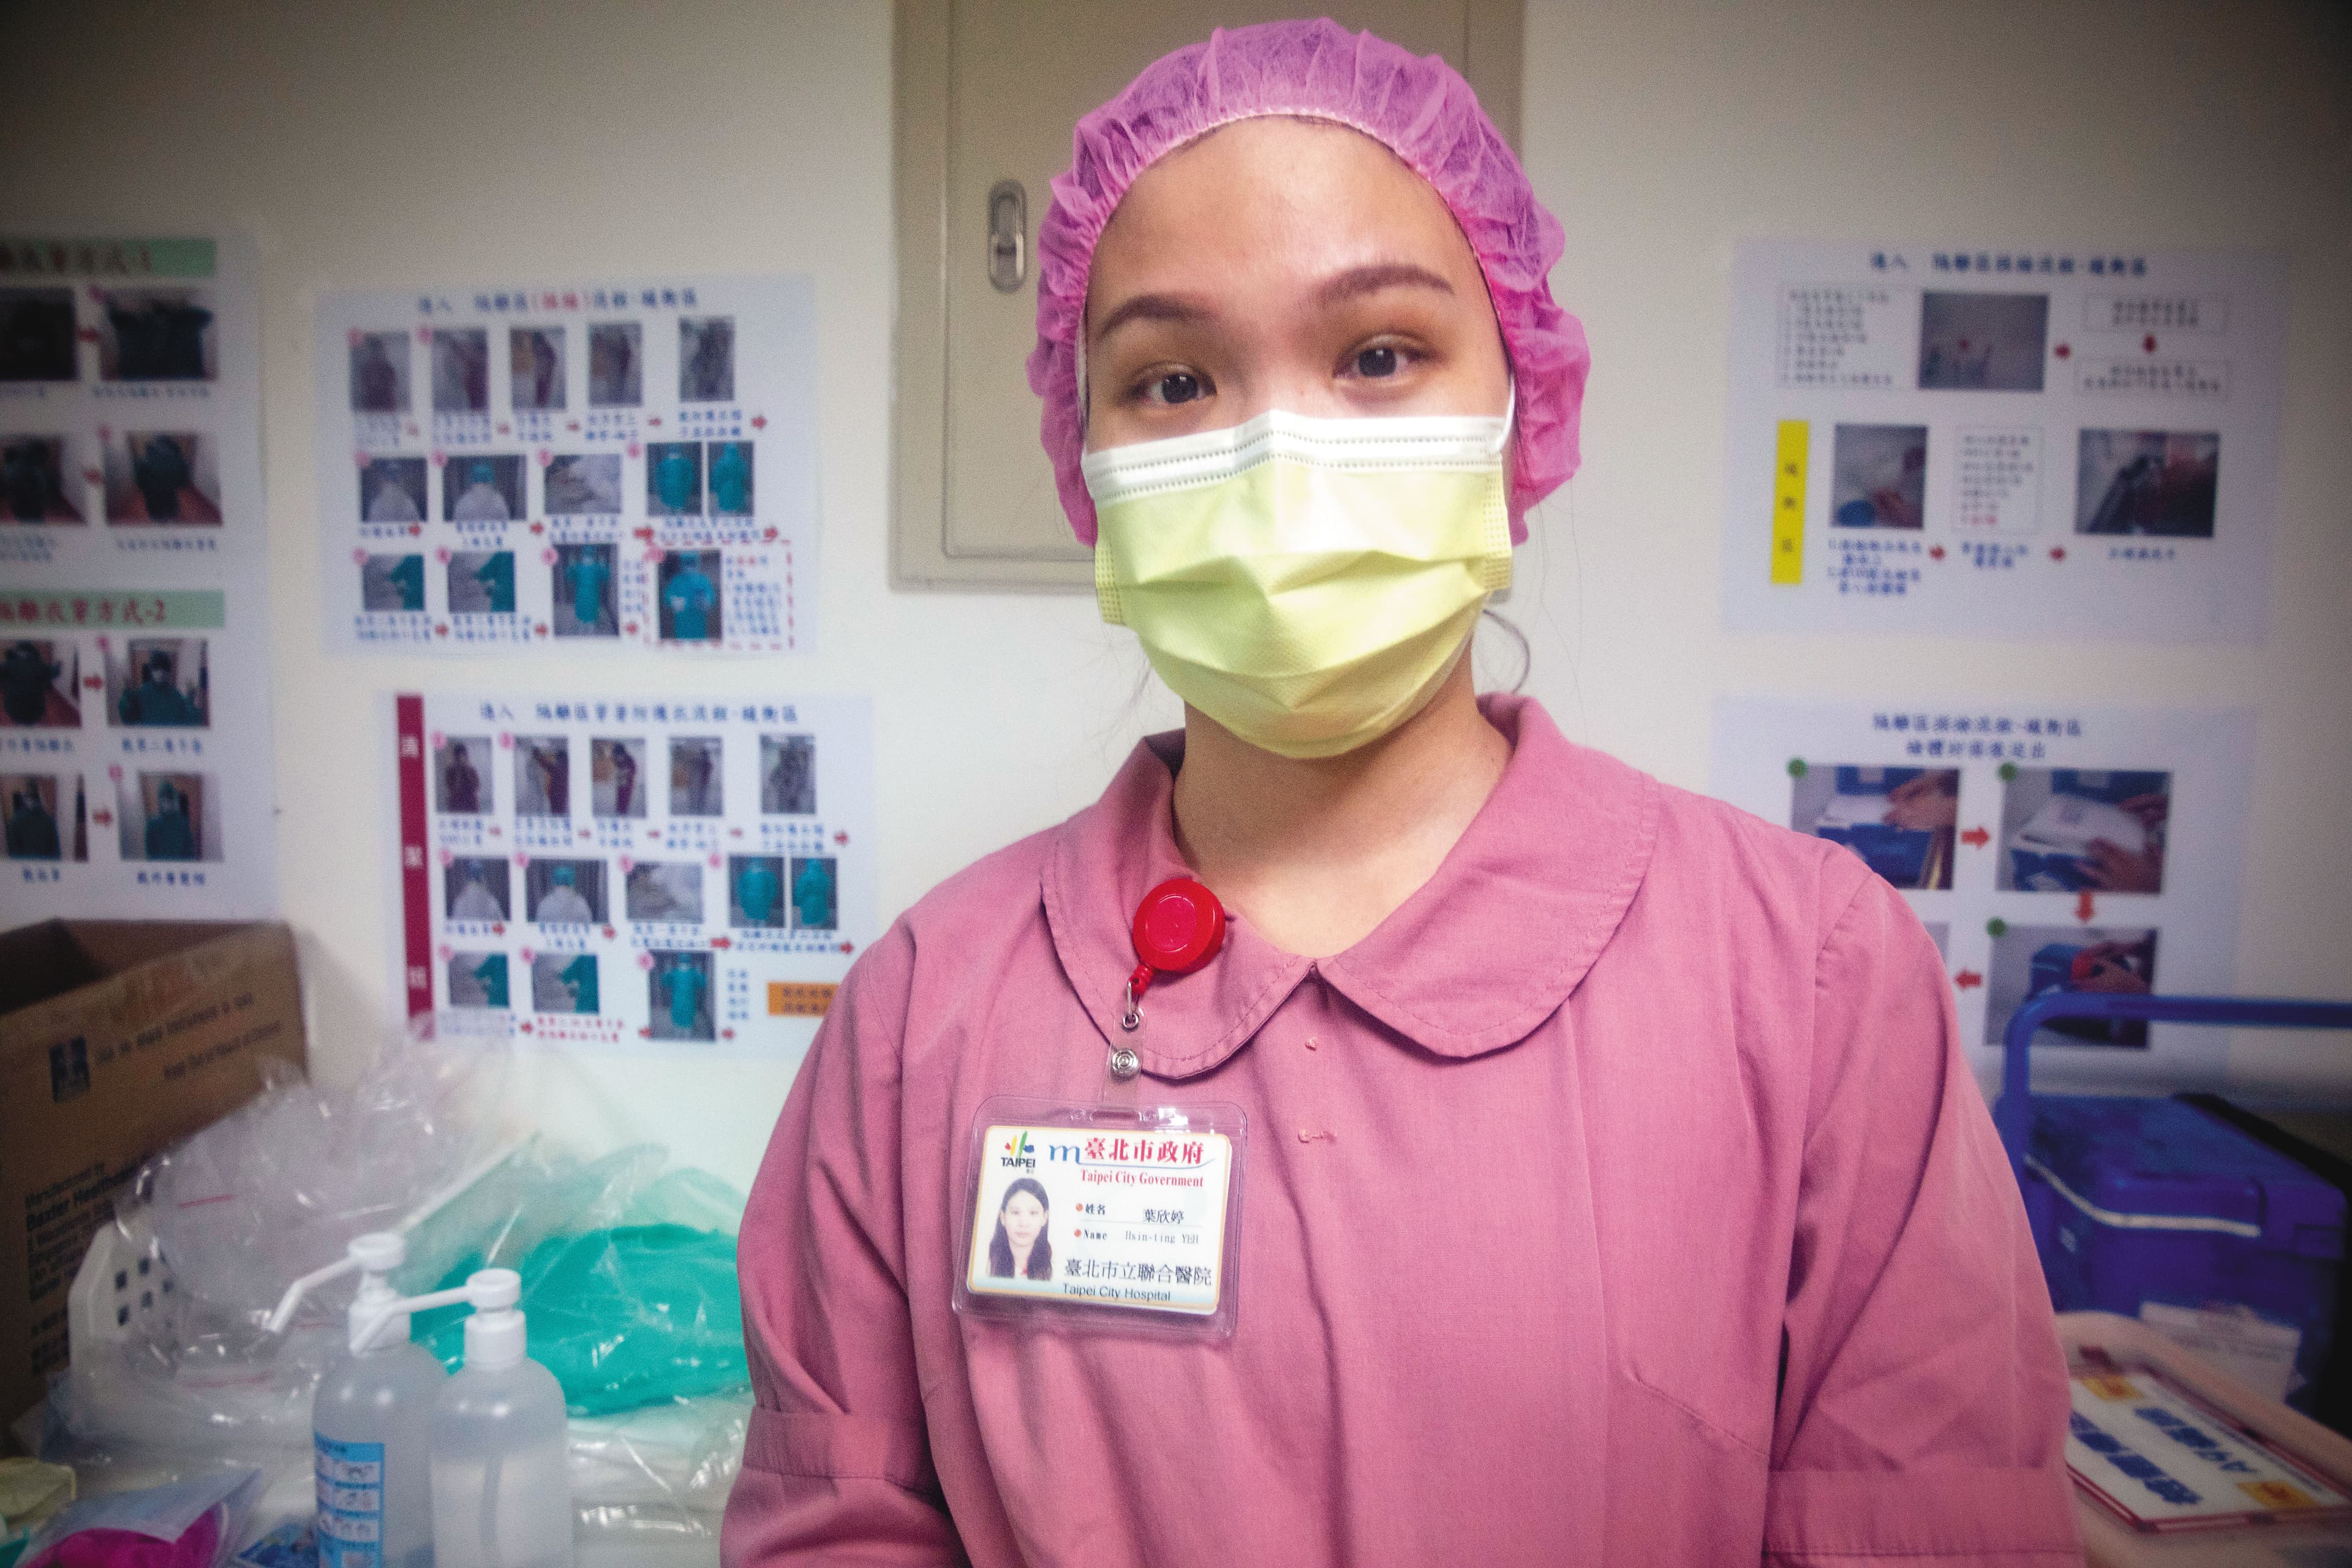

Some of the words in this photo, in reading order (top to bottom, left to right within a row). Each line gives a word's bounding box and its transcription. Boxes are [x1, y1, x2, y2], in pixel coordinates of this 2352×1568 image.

[1085, 1137, 1204, 1164] 臺北市政府
[1001, 1157, 1036, 1168] TAIPEI
[1080, 1169, 1112, 1185] Taipei
[1115, 1170, 1136, 1186] City
[1140, 1172, 1204, 1187] Government
[1085, 1204, 1106, 1216] 姓名
[1143, 1208, 1184, 1224] 葉欣婷
[1084, 1229, 1107, 1240] Name
[1182, 1233, 1199, 1245] YEH
[1065, 1258, 1212, 1286] 臺北市立聯合醫院
[1063, 1283, 1095, 1297] Taipei
[1099, 1286, 1121, 1300] City
[1125, 1288, 1170, 1302] Hospital
